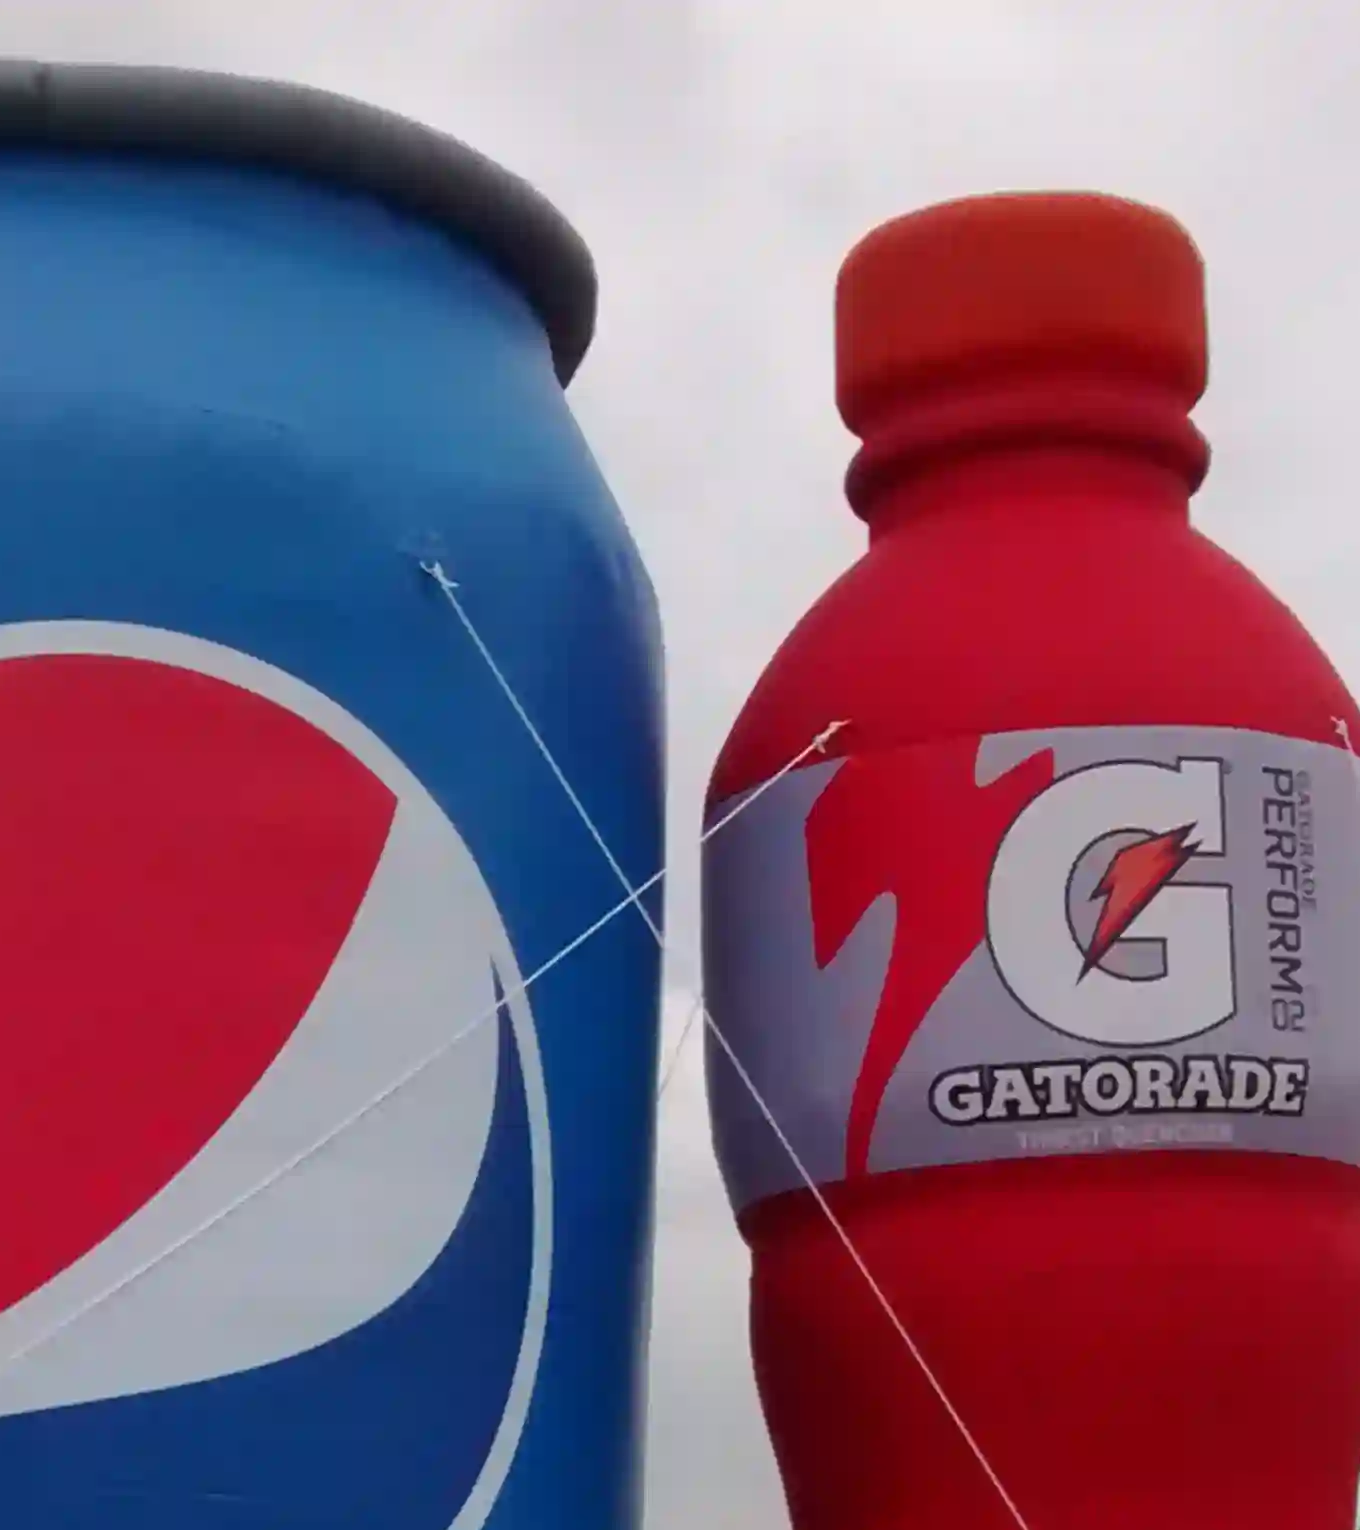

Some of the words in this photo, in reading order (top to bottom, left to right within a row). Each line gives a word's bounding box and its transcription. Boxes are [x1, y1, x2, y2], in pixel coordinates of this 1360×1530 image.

[985, 756, 1238, 1048] G
[1261, 765, 1304, 995] PERFORM
[928, 1054, 1310, 1126] GATORADE
